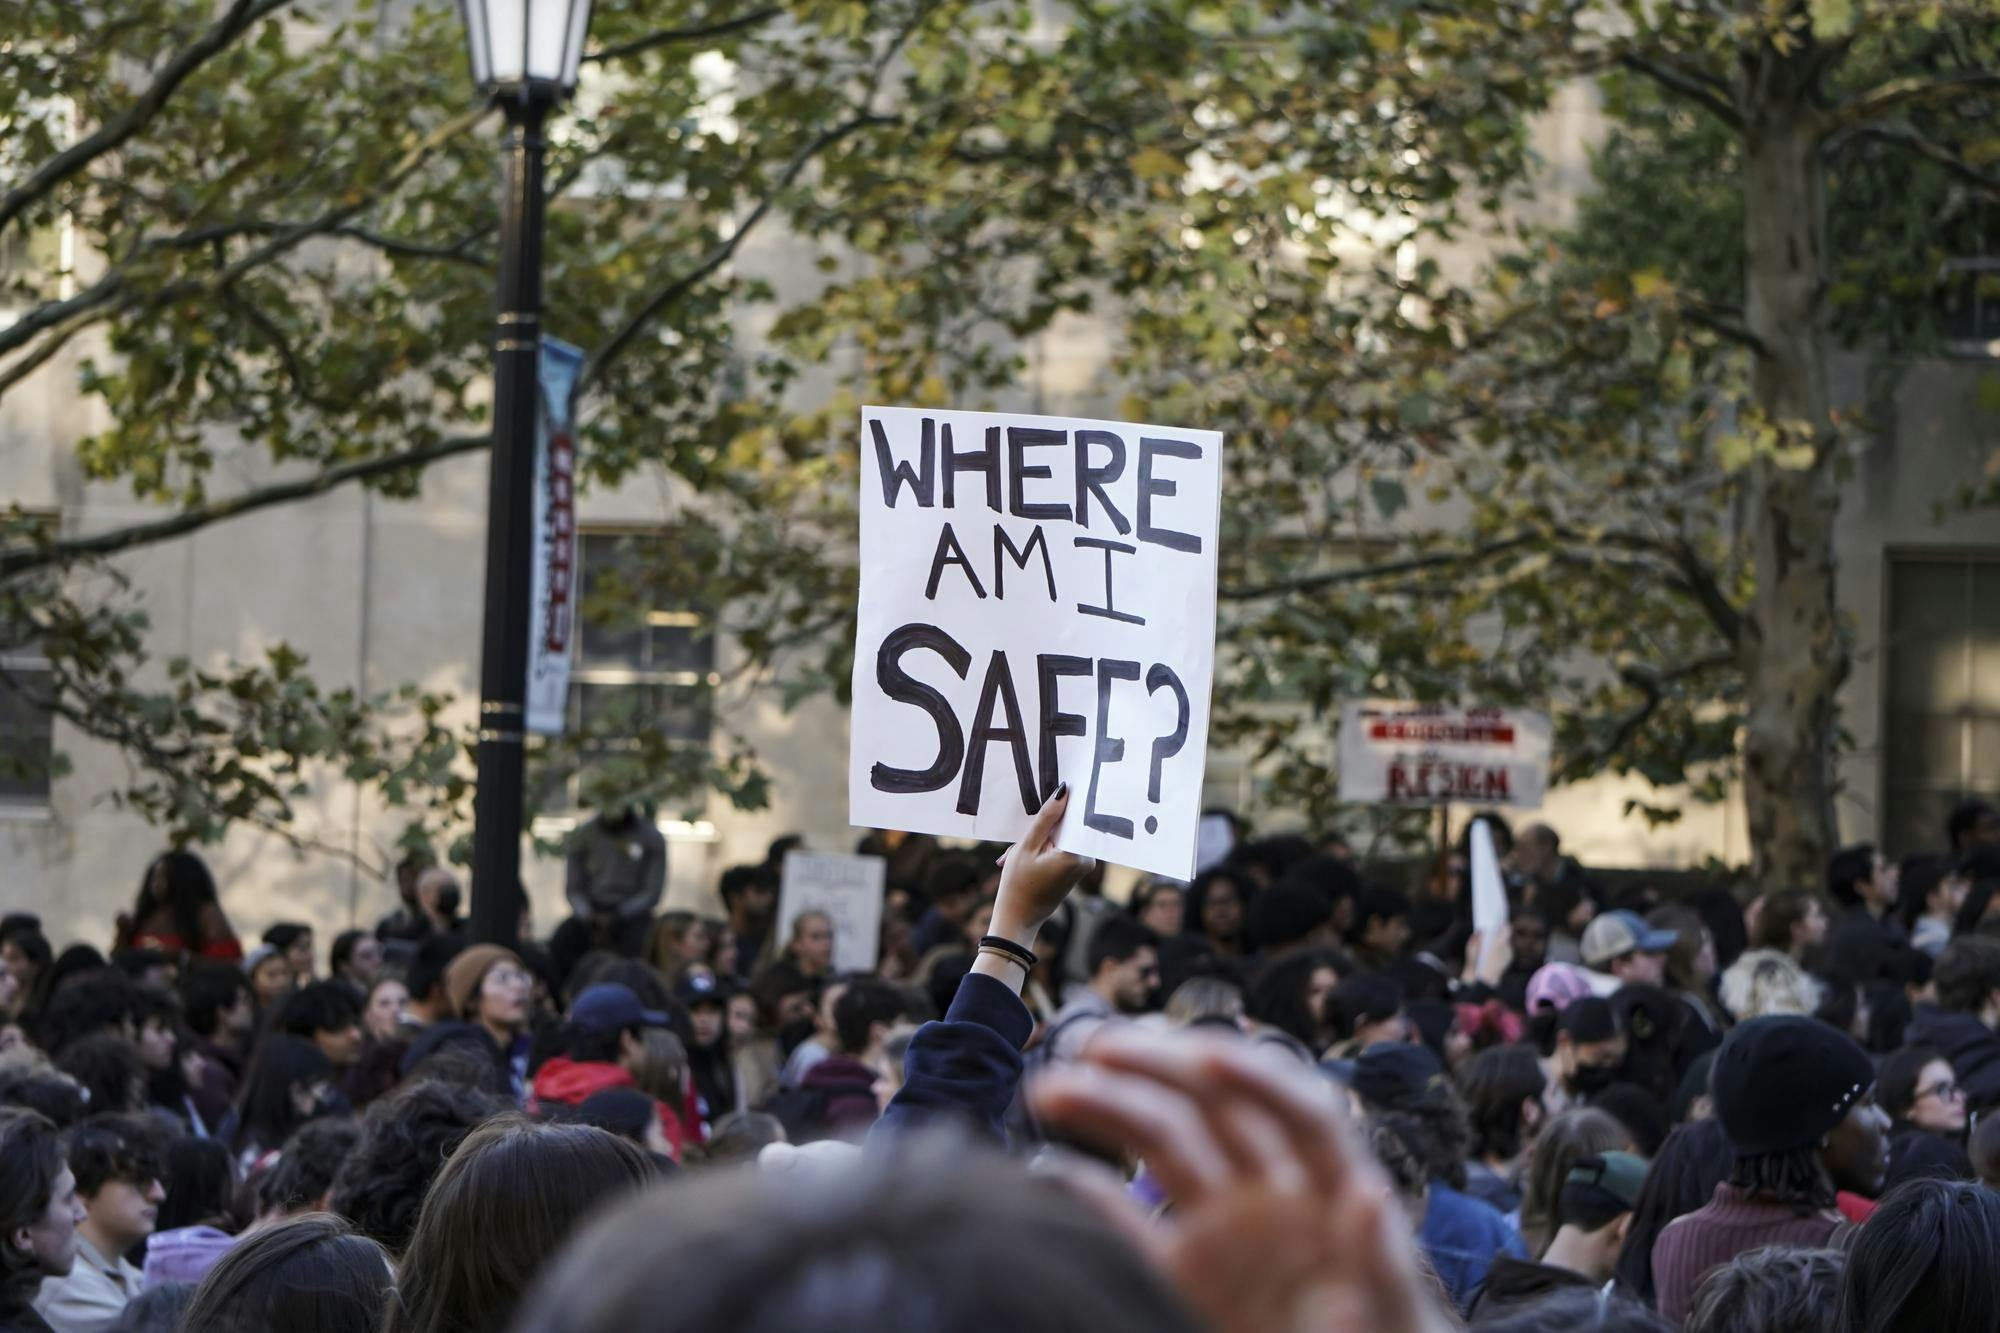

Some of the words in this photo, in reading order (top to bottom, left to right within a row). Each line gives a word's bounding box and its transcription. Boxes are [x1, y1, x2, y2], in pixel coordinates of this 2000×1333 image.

[869, 418, 1202, 554] WHERE
[925, 522, 1057, 602] AM
[1073, 537, 1146, 626] I
[870, 623, 1190, 840] SAFE?
